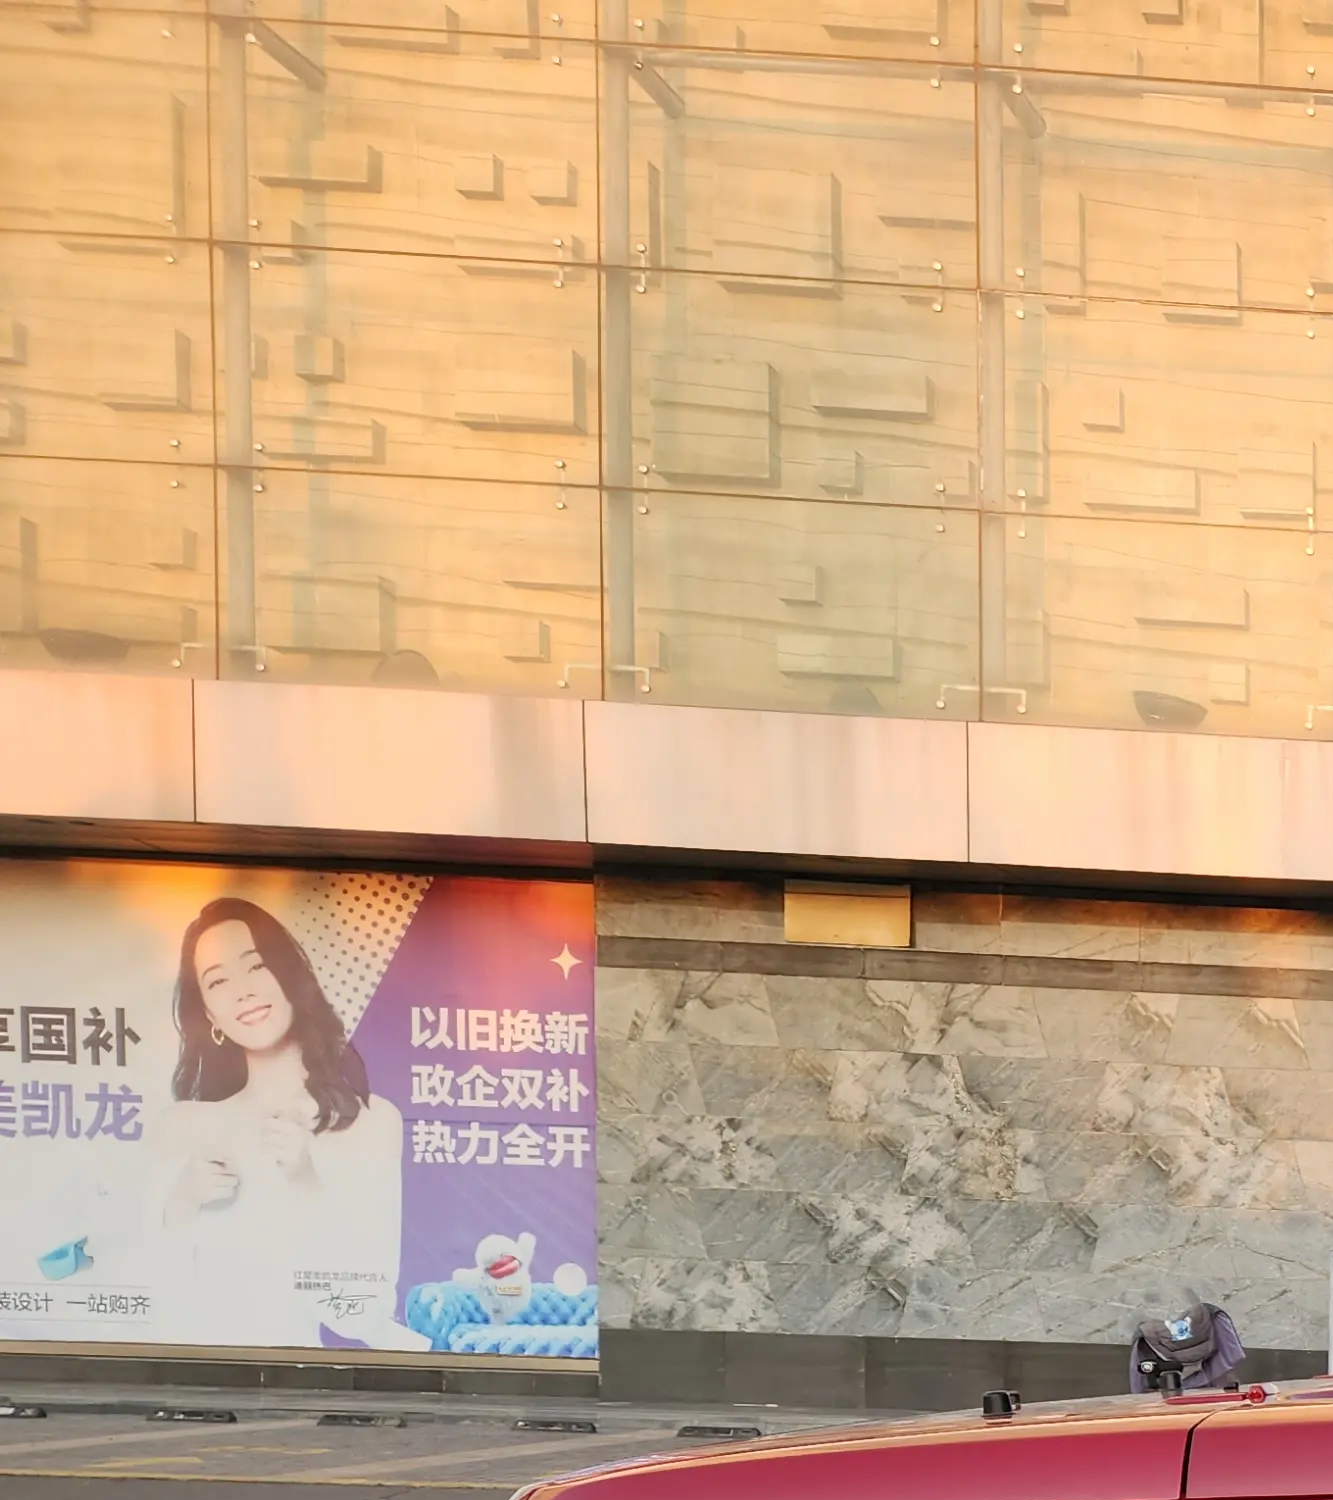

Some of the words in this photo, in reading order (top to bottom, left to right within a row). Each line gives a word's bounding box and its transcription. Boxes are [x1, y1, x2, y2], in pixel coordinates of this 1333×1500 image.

[0, 1006, 142, 1067] 国补
[410, 1006, 590, 1056] 以旧换新
[410, 1063, 590, 1113] 政企双补
[411, 1119, 591, 1169] 热力全开
[66, 1293, 151, 1315] 一站购齐
